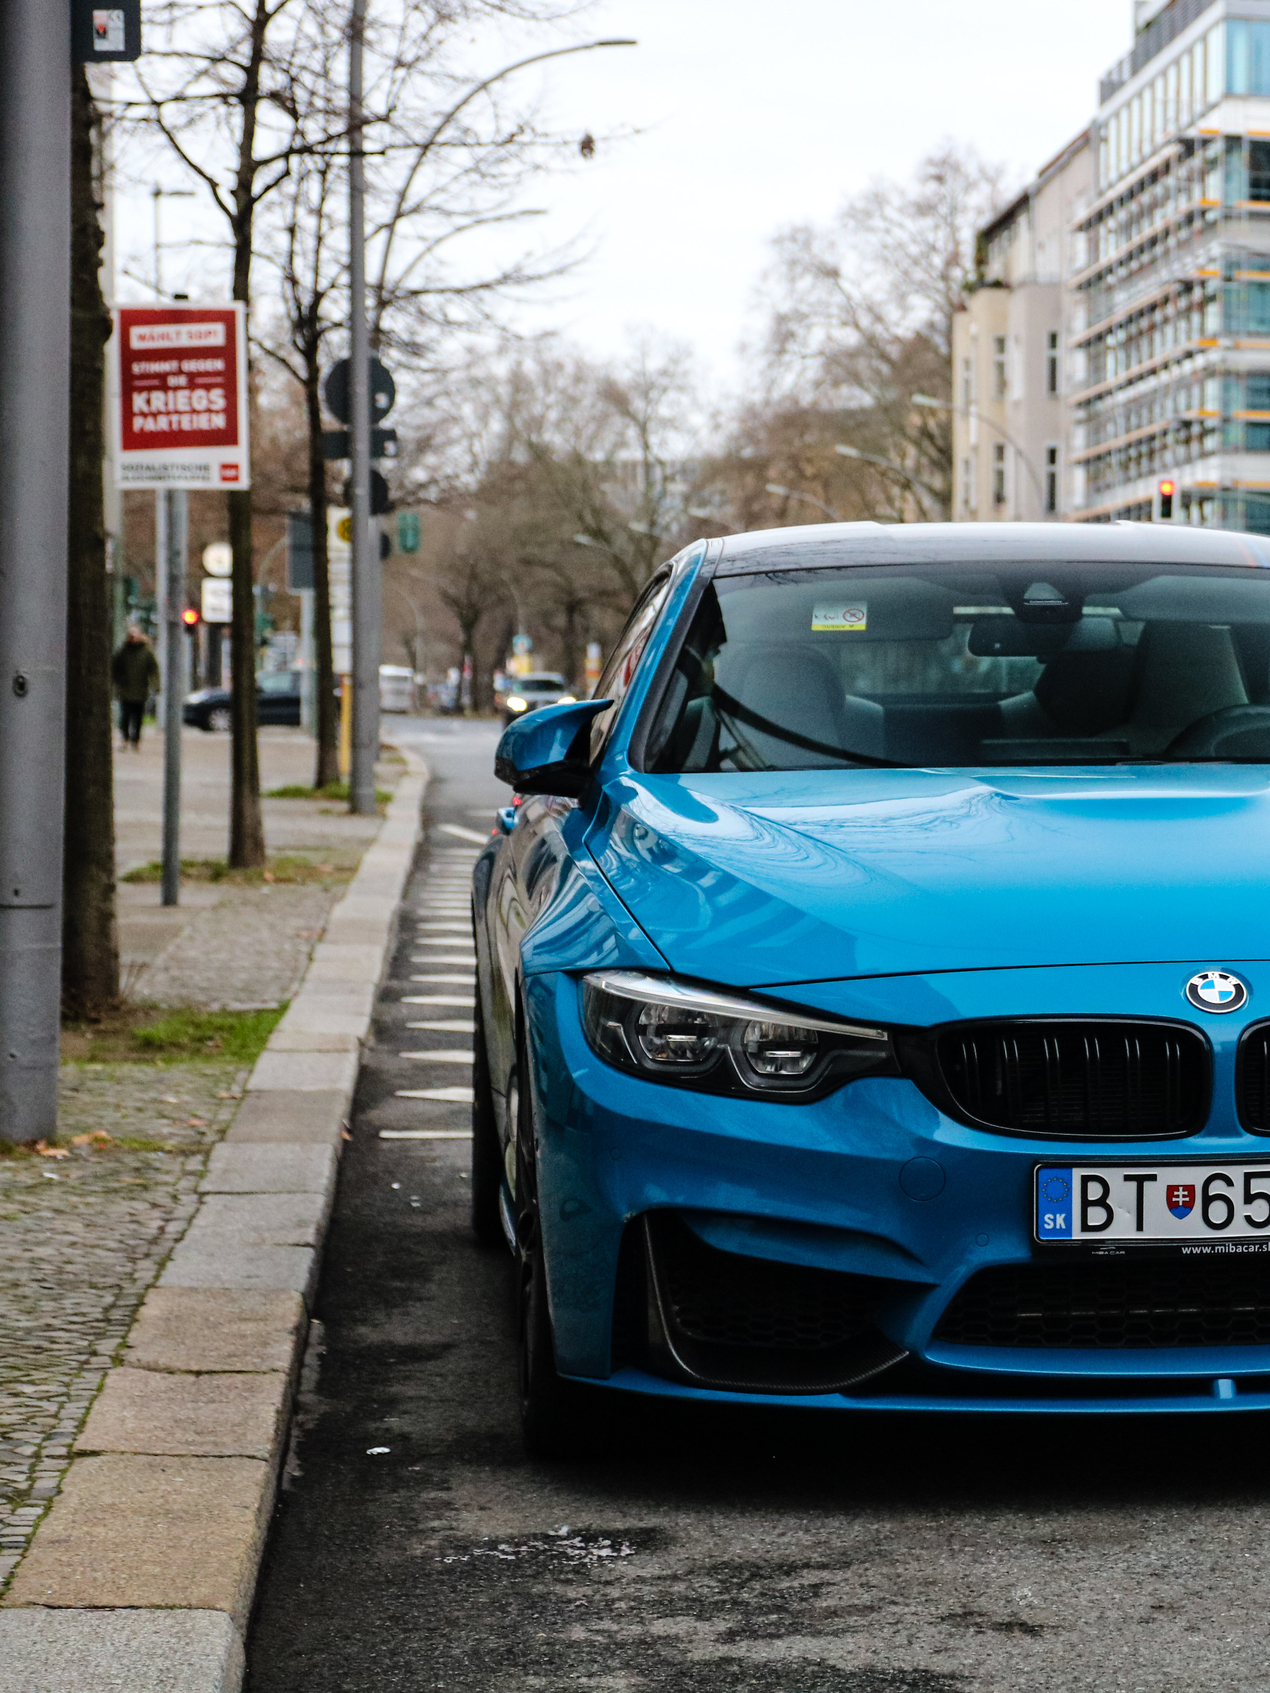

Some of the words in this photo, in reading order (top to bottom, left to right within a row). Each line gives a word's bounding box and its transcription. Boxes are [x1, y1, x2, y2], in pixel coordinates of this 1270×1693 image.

[136, 328, 181, 342] WÄHLT
[131, 360, 179, 375] STIMMT
[181, 358, 224, 373] GEGEN
[167, 374, 187, 387] DIE
[132, 387, 227, 414] KRIEGS
[132, 412, 227, 433] PARTEIEN
[1190, 972, 1240, 985] BMW
[1081, 1172, 1158, 1232] BT
[1043, 1213, 1066, 1229] SK
